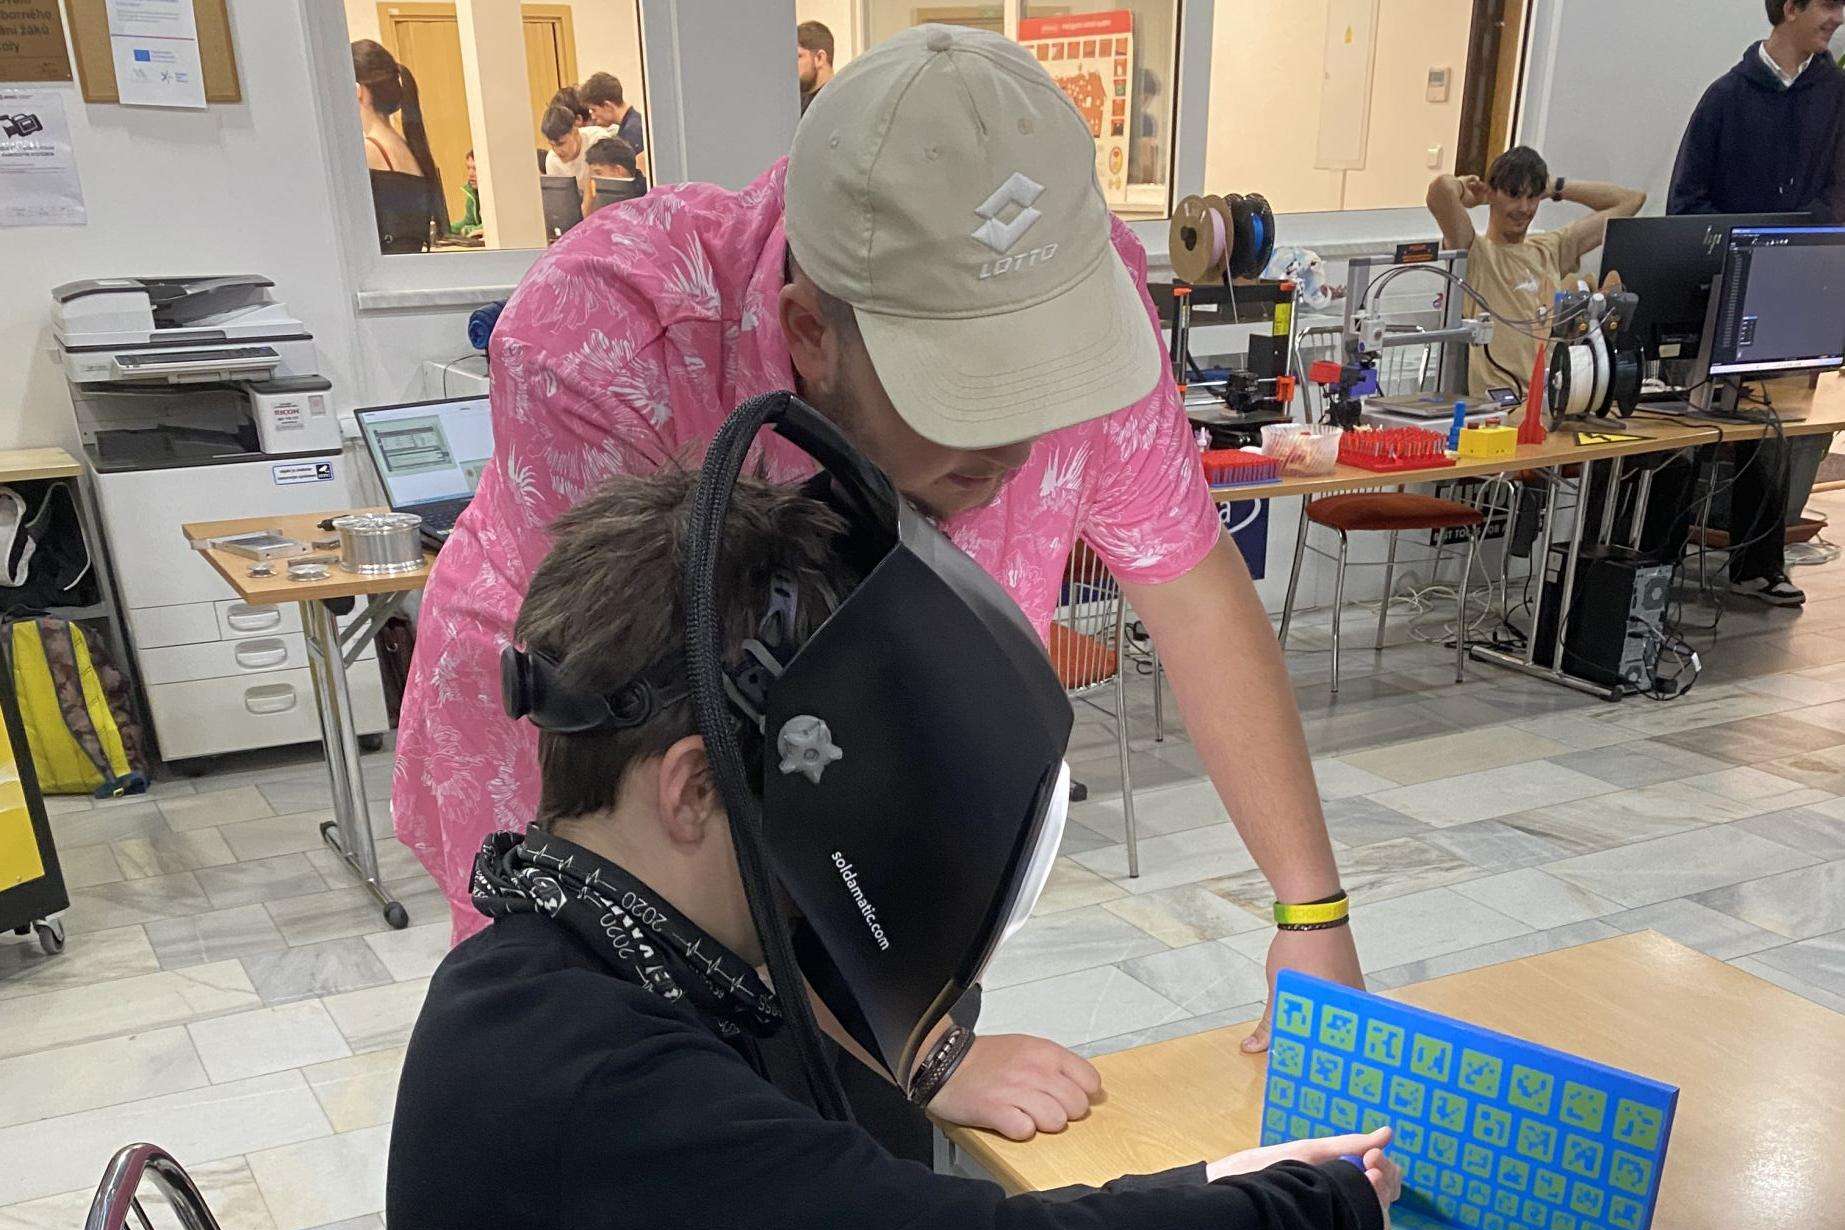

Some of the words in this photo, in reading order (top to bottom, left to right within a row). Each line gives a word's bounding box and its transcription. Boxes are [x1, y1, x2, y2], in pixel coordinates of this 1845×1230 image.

[979, 243, 1058, 280] LOTTO
[621, 892, 668, 932] 2020
[831, 851, 890, 951] soldamatic.com
